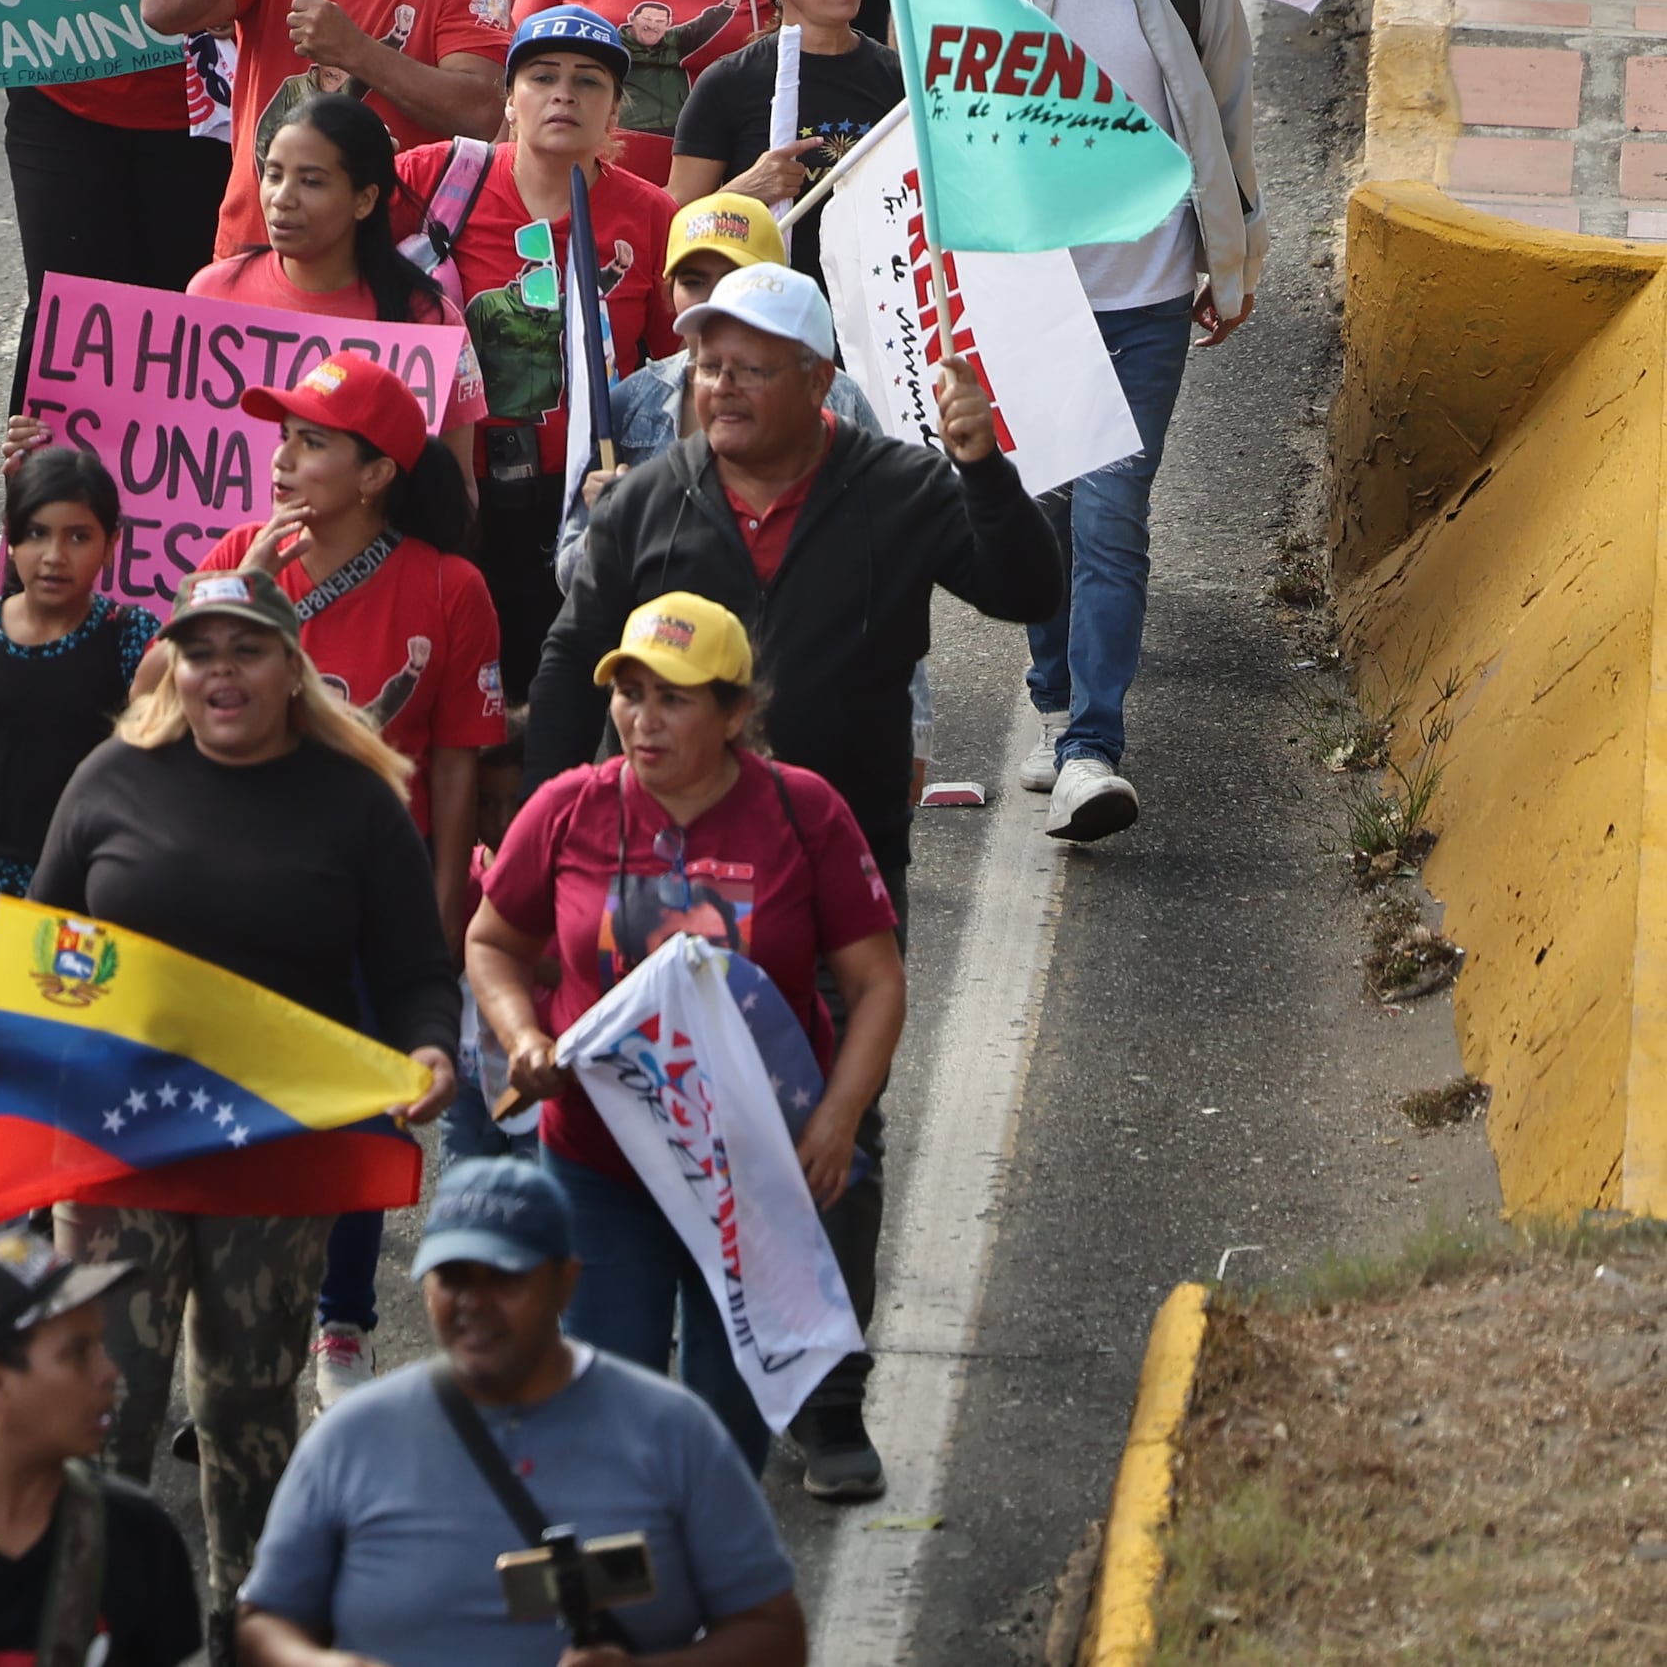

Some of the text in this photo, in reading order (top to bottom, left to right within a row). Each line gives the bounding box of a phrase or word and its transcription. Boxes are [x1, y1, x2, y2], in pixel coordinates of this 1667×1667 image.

[17, 64, 96, 85] FRANCISCO
[103, 60, 124, 76] DE
[717, 211, 750, 225] JURO
[38, 294, 115, 387] LA
[120, 419, 254, 512] UNA
